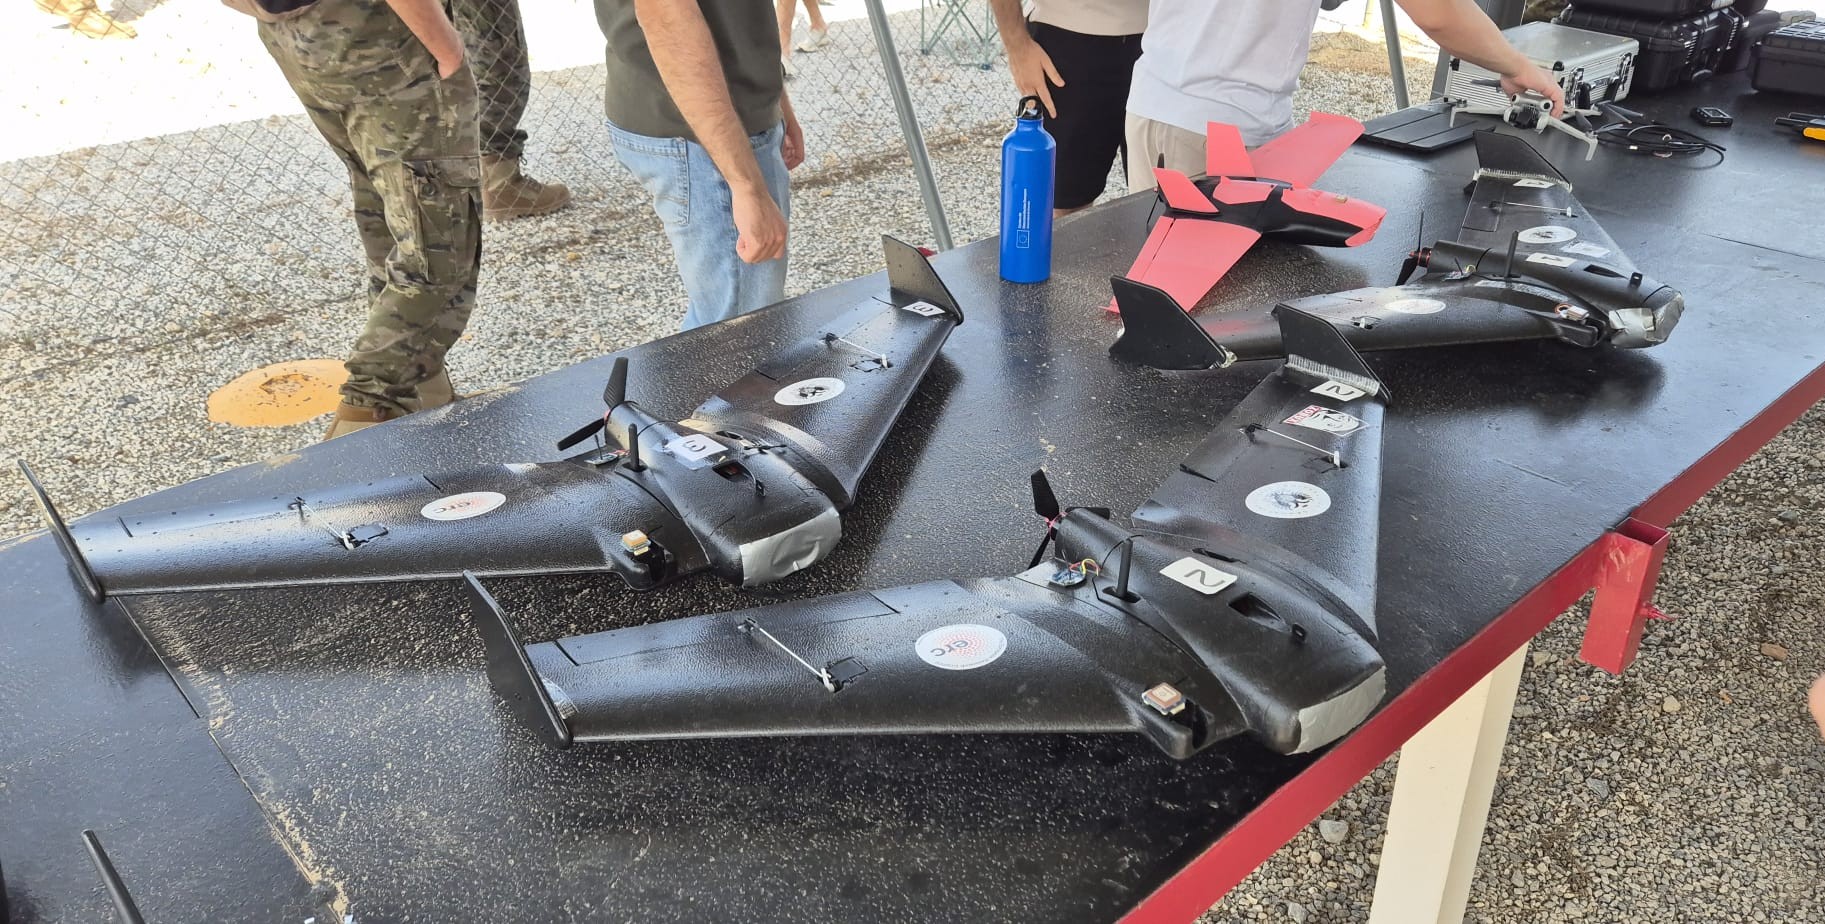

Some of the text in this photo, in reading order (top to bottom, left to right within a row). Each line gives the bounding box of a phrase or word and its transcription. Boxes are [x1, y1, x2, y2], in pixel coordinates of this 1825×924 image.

[912, 304, 934, 313] 3
[682, 439, 706, 453] 3
[1183, 568, 1226, 588] 2
[930, 640, 969, 657] erc
